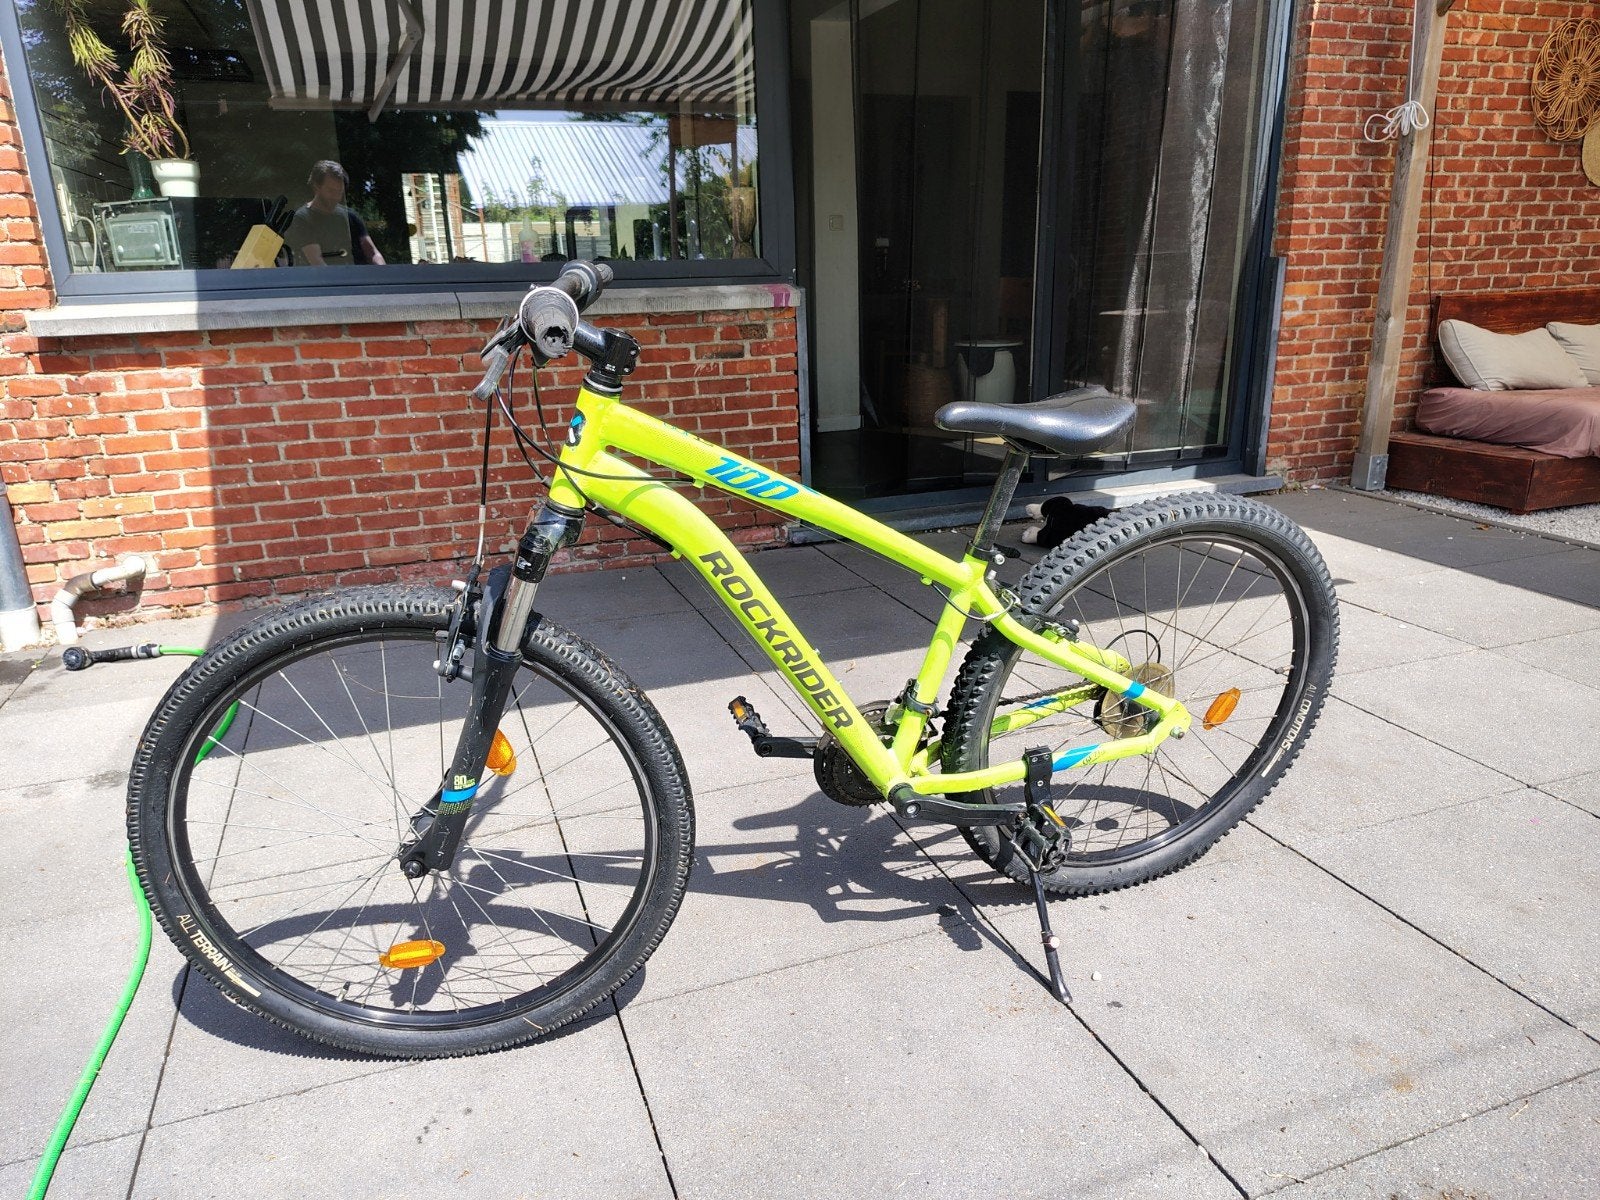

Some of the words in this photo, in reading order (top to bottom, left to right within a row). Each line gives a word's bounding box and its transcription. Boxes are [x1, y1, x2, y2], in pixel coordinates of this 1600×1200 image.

[705, 456, 800, 500] 100
[698, 550, 854, 730] ROCKRIDER
[1280, 699, 1313, 751] CONDITIONS
[453, 775, 467, 786] 80
[176, 913, 197, 934] ALL
[189, 929, 234, 972] TERRAIN
